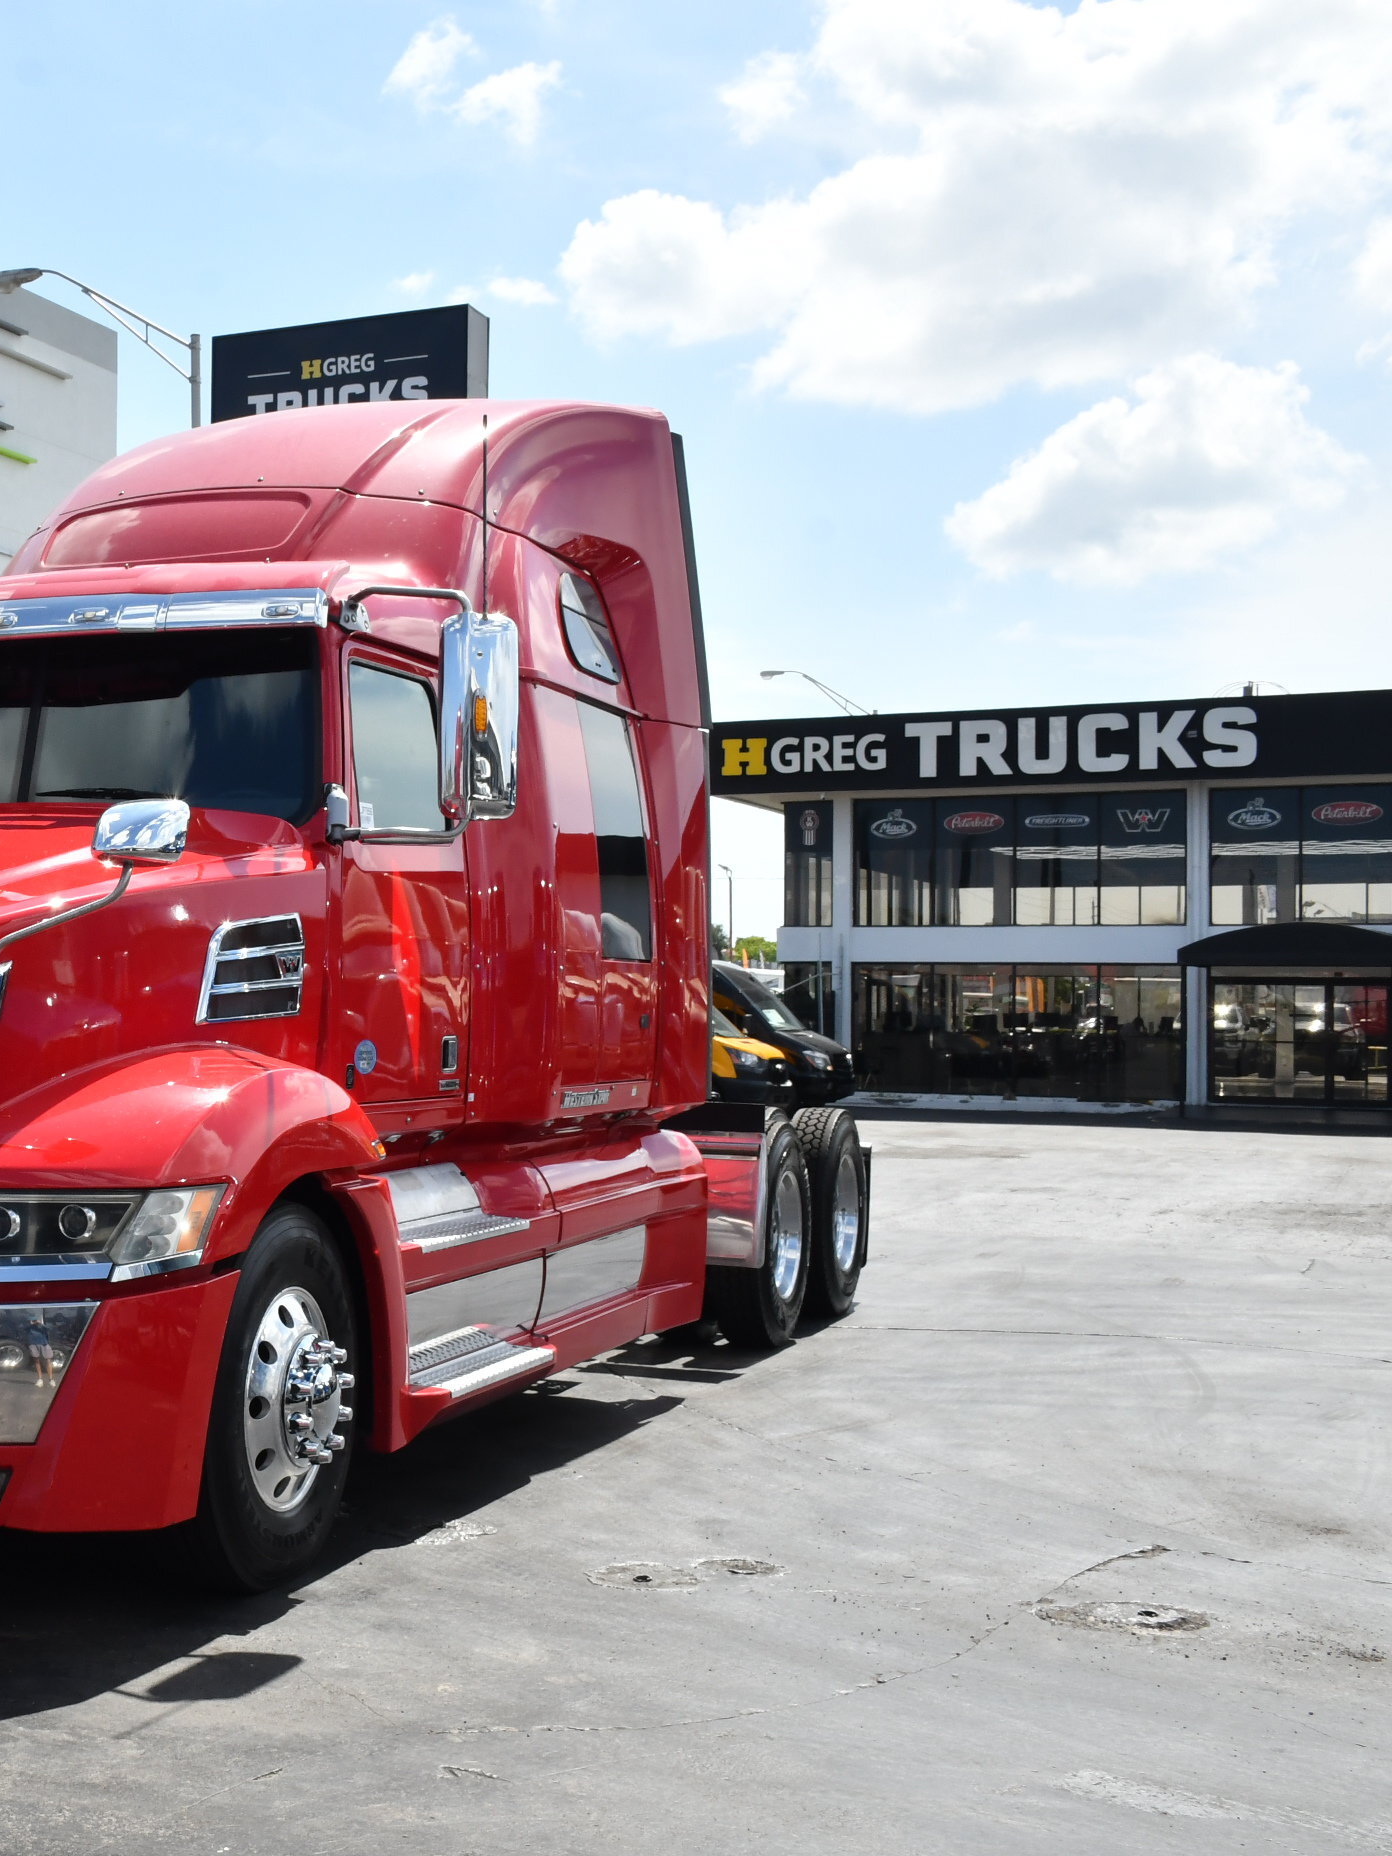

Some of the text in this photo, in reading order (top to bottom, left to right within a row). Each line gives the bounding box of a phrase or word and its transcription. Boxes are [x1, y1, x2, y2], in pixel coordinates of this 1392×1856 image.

[904, 706, 1258, 778] TRUCKS
[1320, 806, 1376, 820] Peterbilt
[951, 814, 1000, 829] Peterbilt
